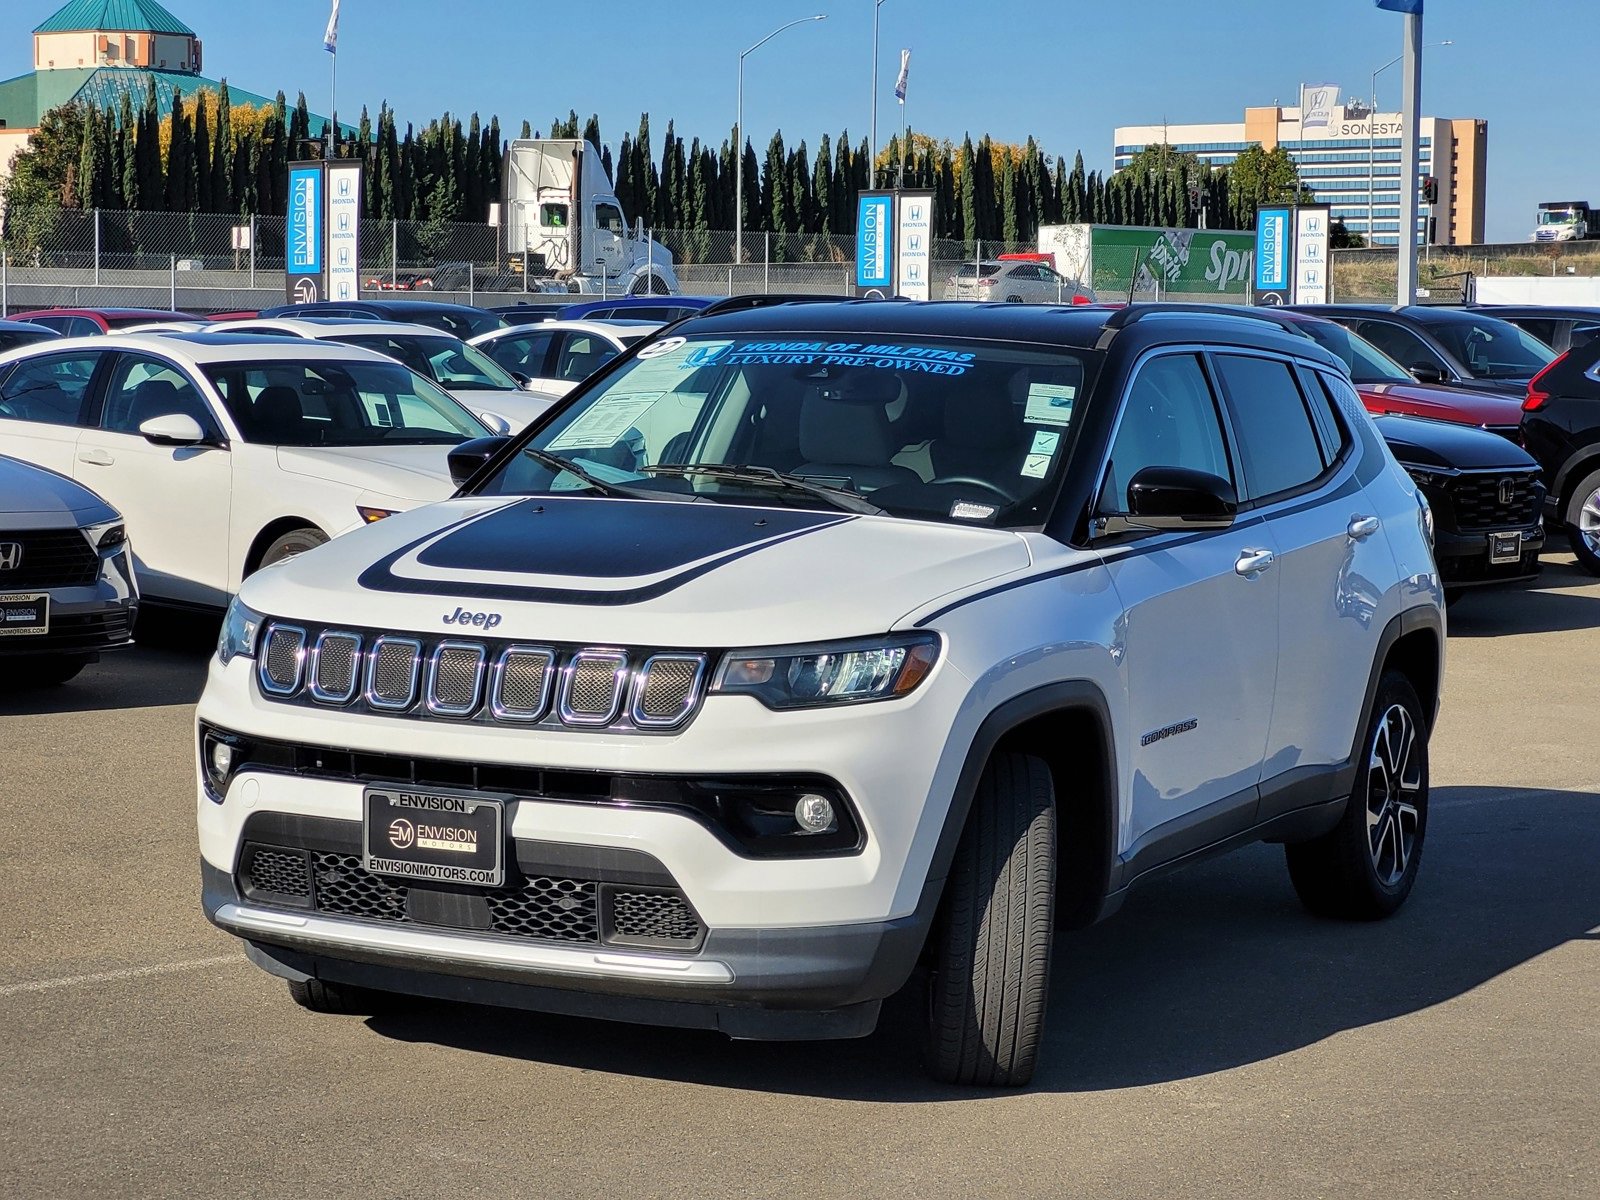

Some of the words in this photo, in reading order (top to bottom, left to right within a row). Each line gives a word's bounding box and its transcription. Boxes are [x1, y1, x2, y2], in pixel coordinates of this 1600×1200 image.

[1341, 123, 1402, 135] SONESTA
[294, 178, 306, 265] ENVISION
[864, 204, 876, 279] ENVISION
[1262, 216, 1275, 283] ENVISION
[1150, 235, 1182, 282] Sprite
[737, 342, 822, 351] HONDA
[825, 343, 862, 352] OF
[859, 344, 976, 362] MILPITAS
[725, 355, 822, 365] LUXURY
[823, 355, 965, 376] PRE-OWNED
[443, 607, 502, 630] Jeep
[1141, 718, 1198, 746] COMPASS
[400, 794, 465, 812] ENVISION
[417, 824, 477, 843] ENVISION
[422, 840, 472, 851] MOTORS
[369, 859, 495, 883] ENVISIONMOTORS.COM
